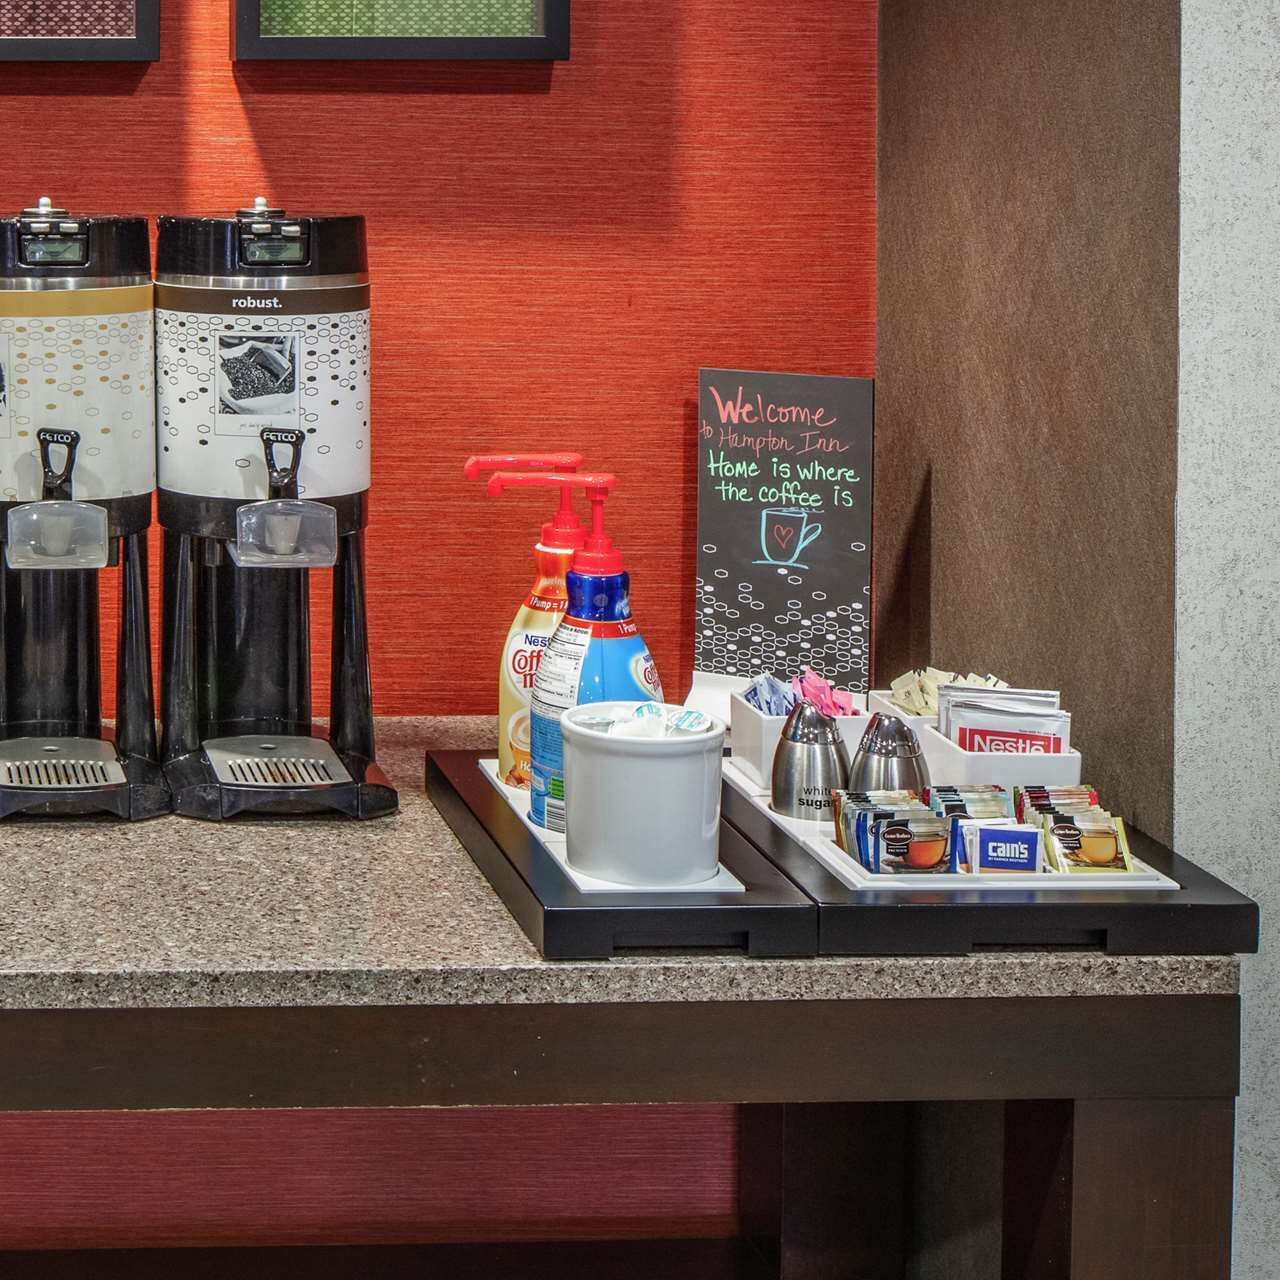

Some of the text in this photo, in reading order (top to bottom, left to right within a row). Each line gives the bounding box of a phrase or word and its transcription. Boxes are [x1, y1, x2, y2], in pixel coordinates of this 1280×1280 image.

[232, 296, 282, 308] robust.
[709, 386, 837, 427] Welcome
[40, 432, 72, 443] FETCO
[263, 431, 296, 442] FETCO
[700, 420, 849, 458] to Hampton Inn
[772, 457, 790, 478] is
[797, 461, 861, 482] where
[715, 480, 853, 507] the coffee is
[524, 634, 550, 648] Nes
[798, 798, 833, 810] suga
